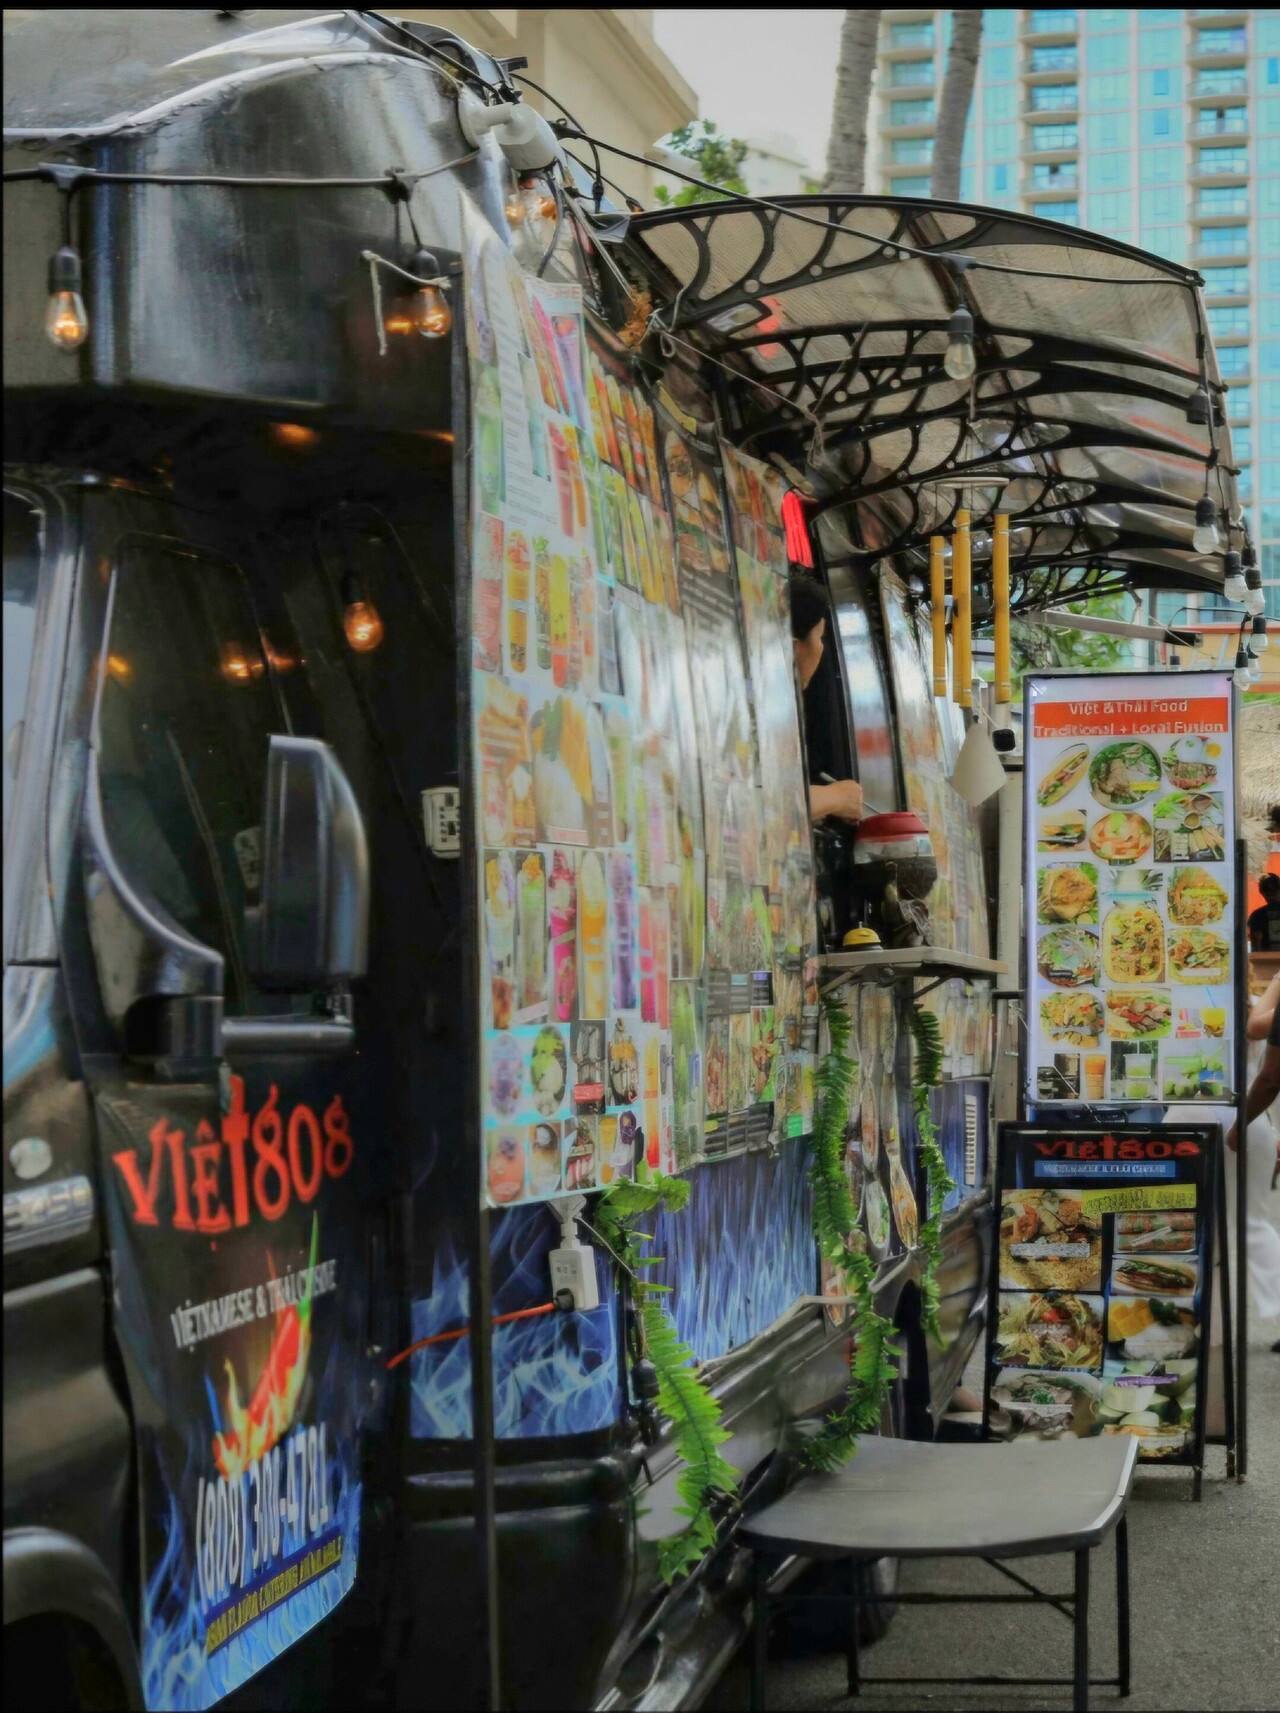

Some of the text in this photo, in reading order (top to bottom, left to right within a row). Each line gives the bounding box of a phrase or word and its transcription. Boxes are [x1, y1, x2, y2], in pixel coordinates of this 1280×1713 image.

[1069, 702, 1100, 716] Viet
[1116, 700, 1147, 714] Thai
[1151, 699, 1189, 713] Food
[1035, 723, 1115, 737] Traditional
[1132, 722, 1172, 736] Local
[1174, 720, 1225, 735] Fusion
